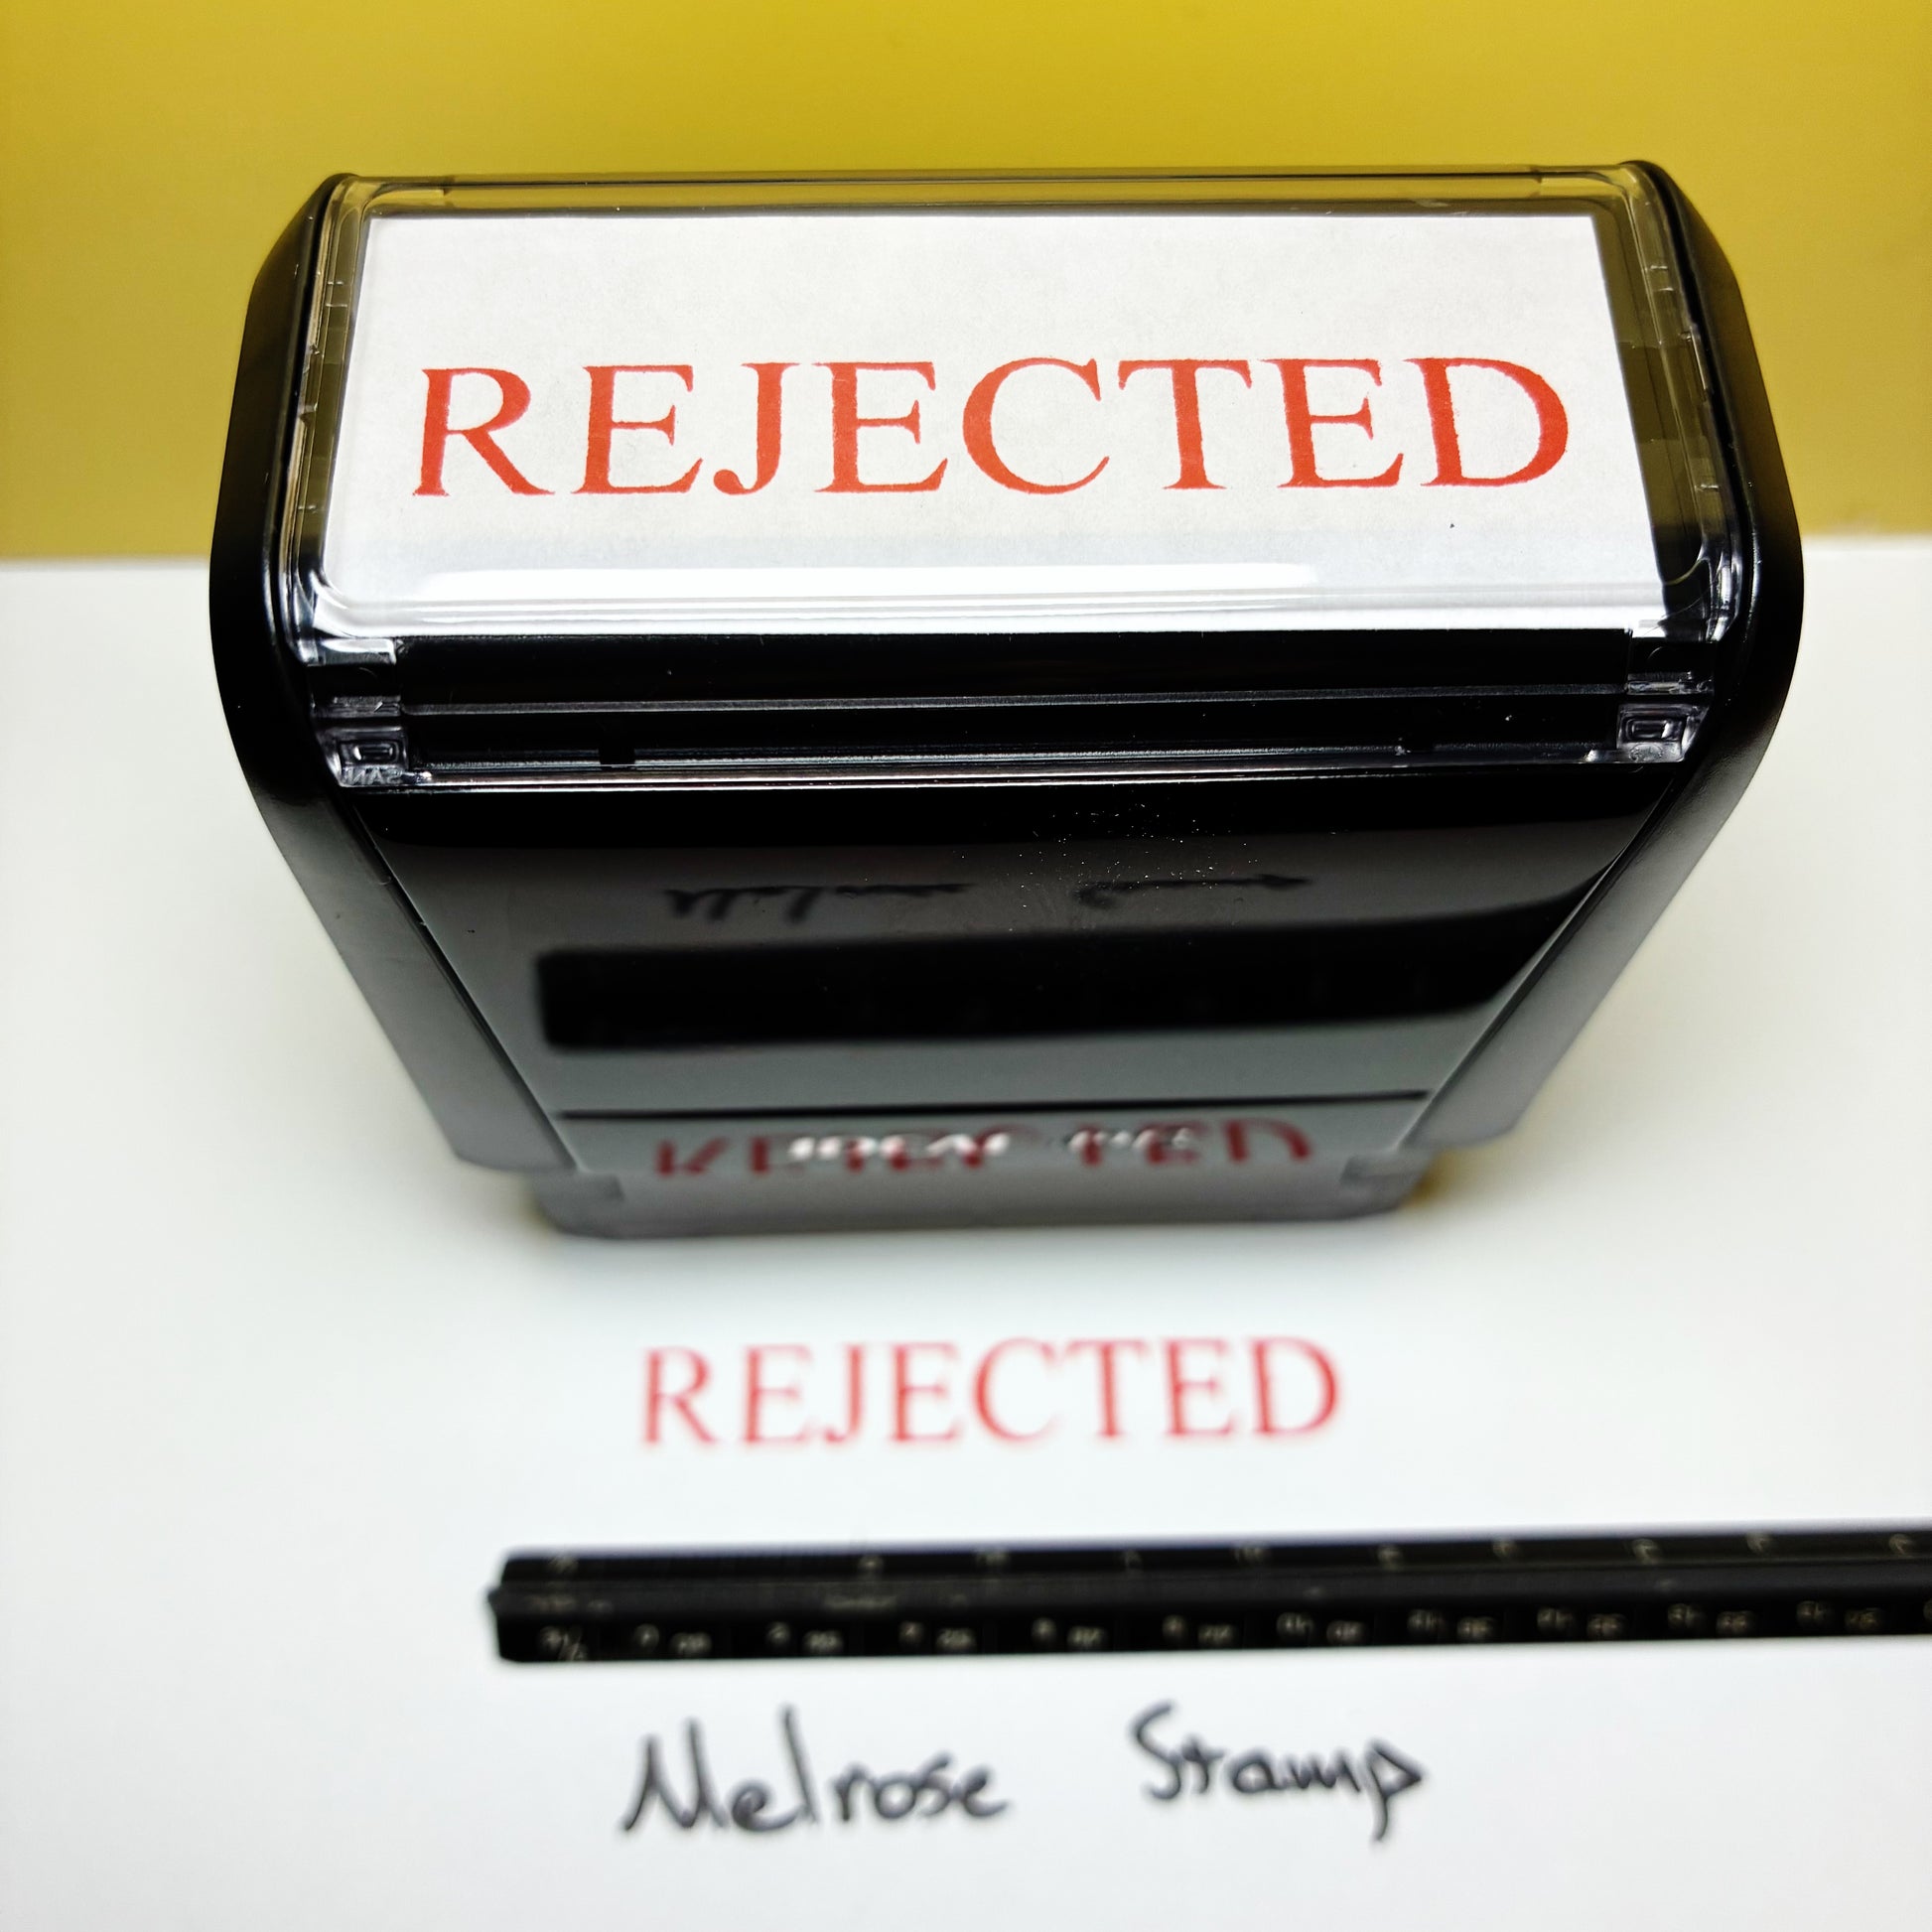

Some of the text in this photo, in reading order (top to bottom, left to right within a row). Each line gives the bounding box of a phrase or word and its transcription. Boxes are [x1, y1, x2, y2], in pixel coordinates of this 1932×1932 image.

[413, 356, 1570, 497] REJECTED
[643, 1337, 1342, 1448] REJECTED
[621, 1704, 1424, 1843] Melrose Stamp
